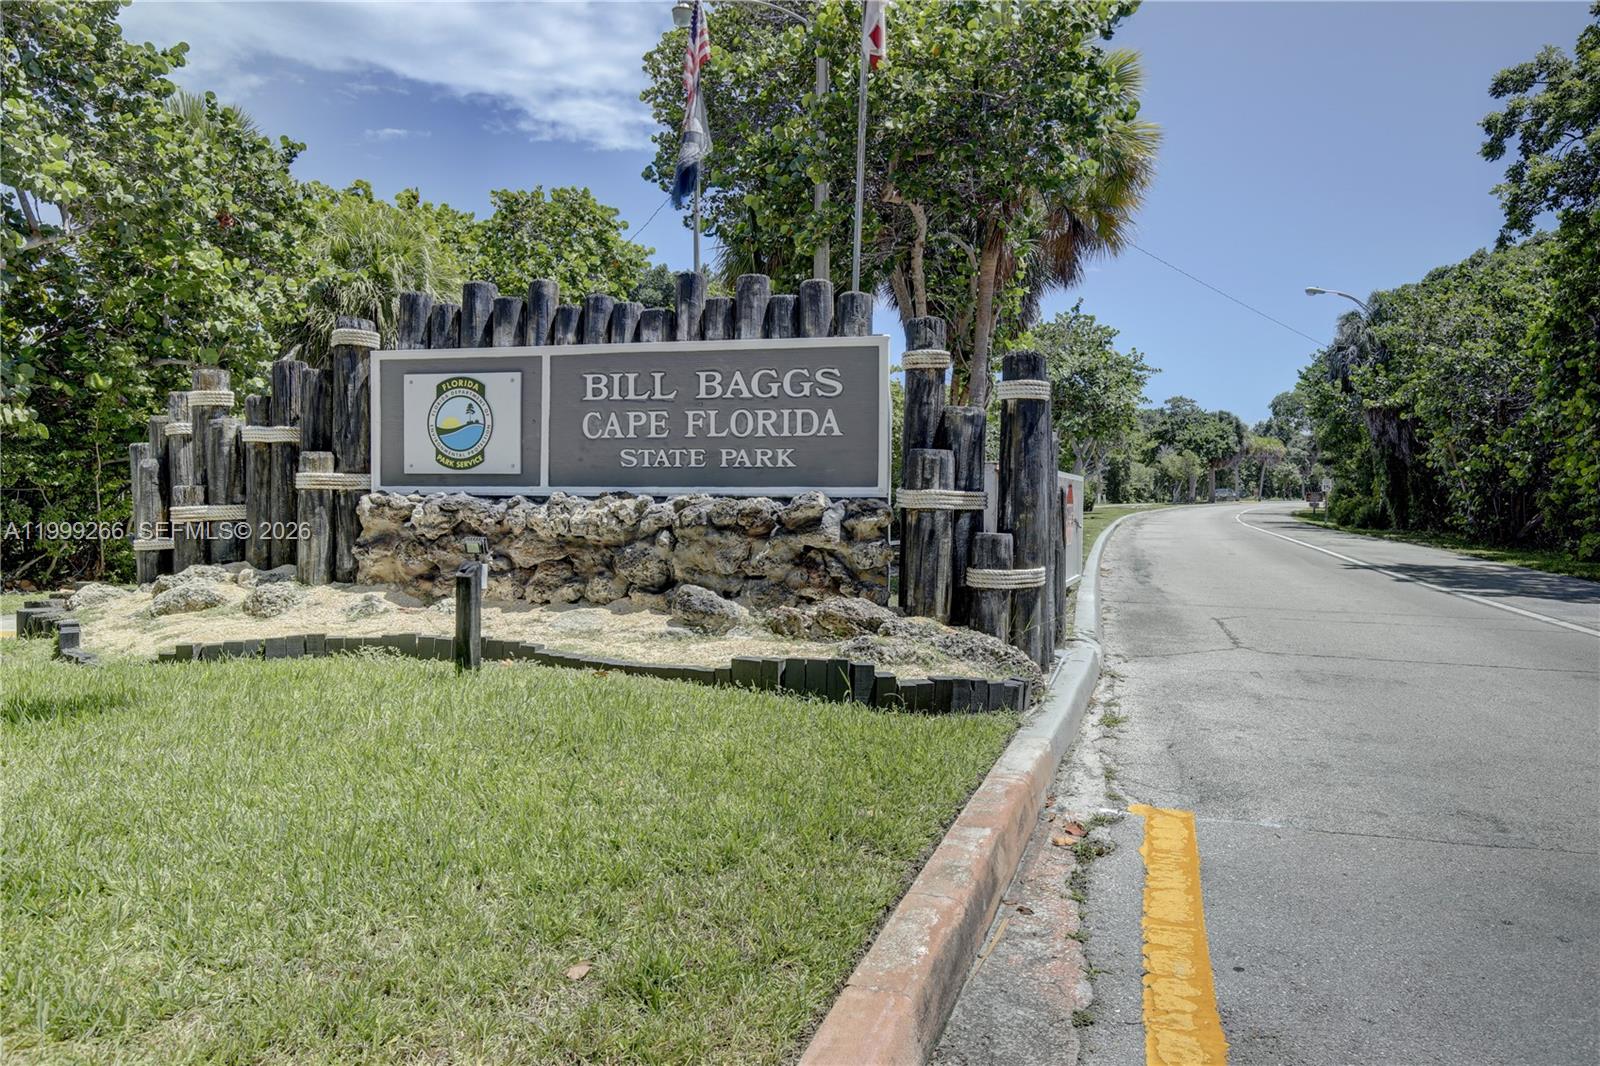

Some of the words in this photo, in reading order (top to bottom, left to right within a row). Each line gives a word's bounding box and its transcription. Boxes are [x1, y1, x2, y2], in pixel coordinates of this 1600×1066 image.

[441, 379, 479, 391] FLORIDA
[582, 372, 678, 401] BILL
[695, 368, 844, 400] BAGGS
[582, 410, 671, 440] CAPE
[684, 408, 843, 438] FLORIDA
[436, 454, 455, 467] PARK
[456, 455, 483, 468] SERVICE
[620, 448, 707, 468] STATE
[719, 448, 797, 467] PARK
